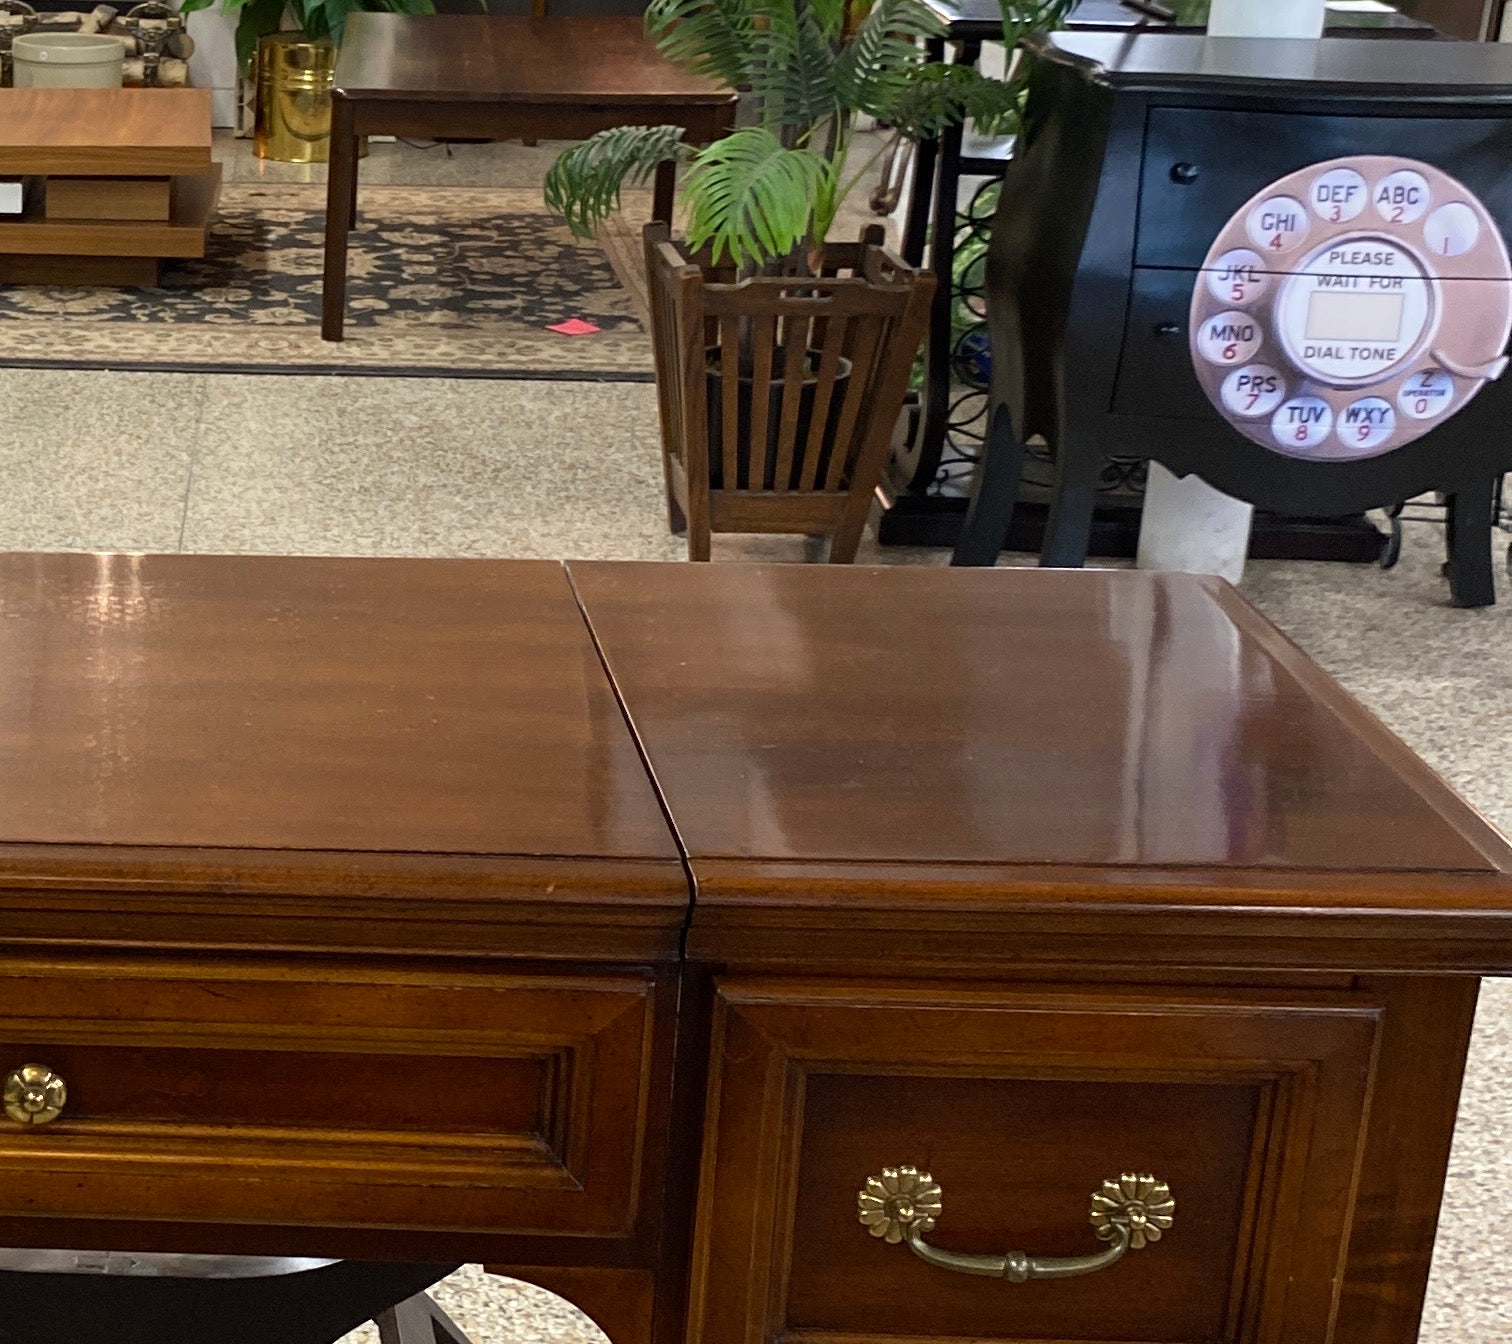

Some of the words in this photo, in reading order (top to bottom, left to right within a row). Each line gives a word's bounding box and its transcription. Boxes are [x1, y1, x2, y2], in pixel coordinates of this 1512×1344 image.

[1317, 185, 1359, 203] DEF
[1377, 186, 1420, 205] ABC
[1329, 205, 1341, 222] 3
[1390, 206, 1405, 223] 2
[1261, 213, 1296, 232] GHI
[1269, 233, 1282, 248] 4
[1329, 251, 1395, 266] PLEASE
[1217, 264, 1261, 283] JKL
[1317, 276, 1358, 288] WAIT
[1369, 277, 1404, 289] FOR
[1231, 284, 1244, 301] 5
[1210, 324, 1255, 342] MNO
[1222, 343, 1237, 360] 6
[1303, 346, 1344, 359] DIAL
[1349, 347, 1397, 361] TONE
[1236, 375, 1277, 393] PRS
[1420, 371, 1434, 387] Z
[1245, 393, 1259, 411] 7
[1288, 406, 1326, 423] TUV
[1345, 407, 1390, 424] WXY
[1295, 425, 1309, 441] 8
[1357, 424, 1371, 442] 9
